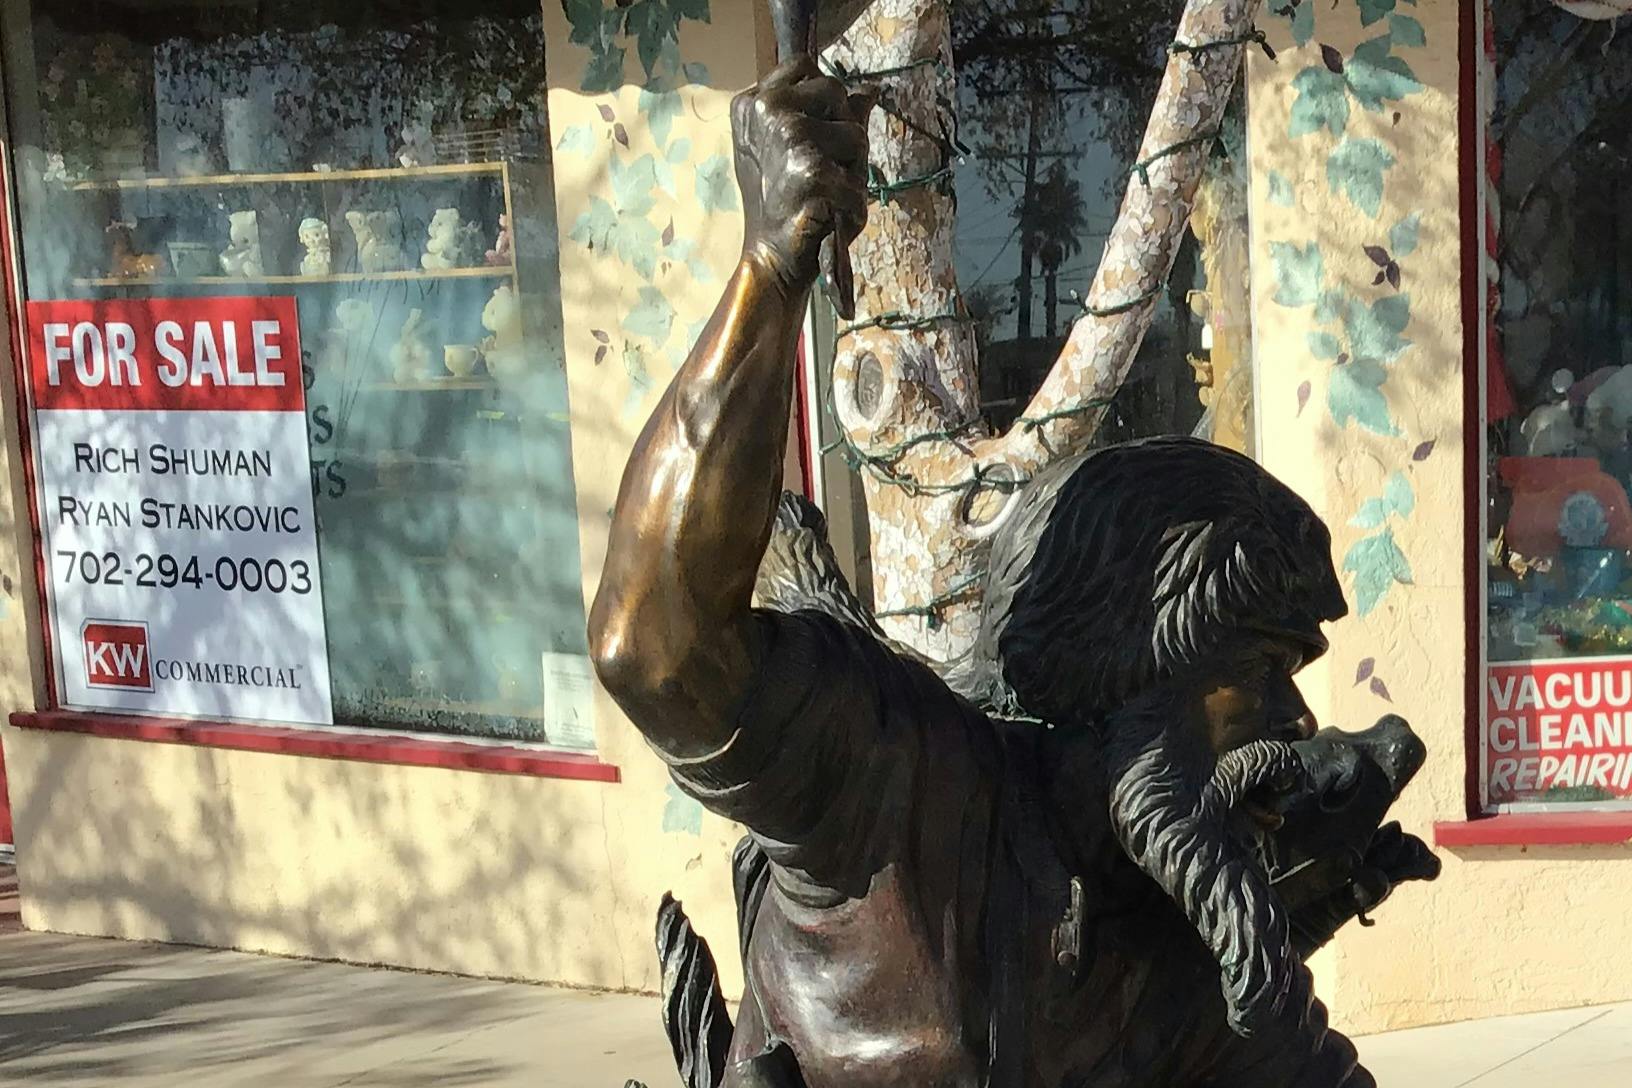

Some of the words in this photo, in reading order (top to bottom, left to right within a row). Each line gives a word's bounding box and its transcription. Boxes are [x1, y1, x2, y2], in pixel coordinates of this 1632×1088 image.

[43, 320, 142, 388] FOR
[154, 319, 286, 388] SALE
[74, 442, 140, 475] RICH
[149, 444, 272, 478] SHUMAN
[57, 495, 132, 528] RYAN
[140, 498, 301, 534] STANKOVIC
[57, 549, 313, 595] 702-294-0003
[87, 641, 147, 679] KW
[155, 658, 302, 690] COMMERCIAL
